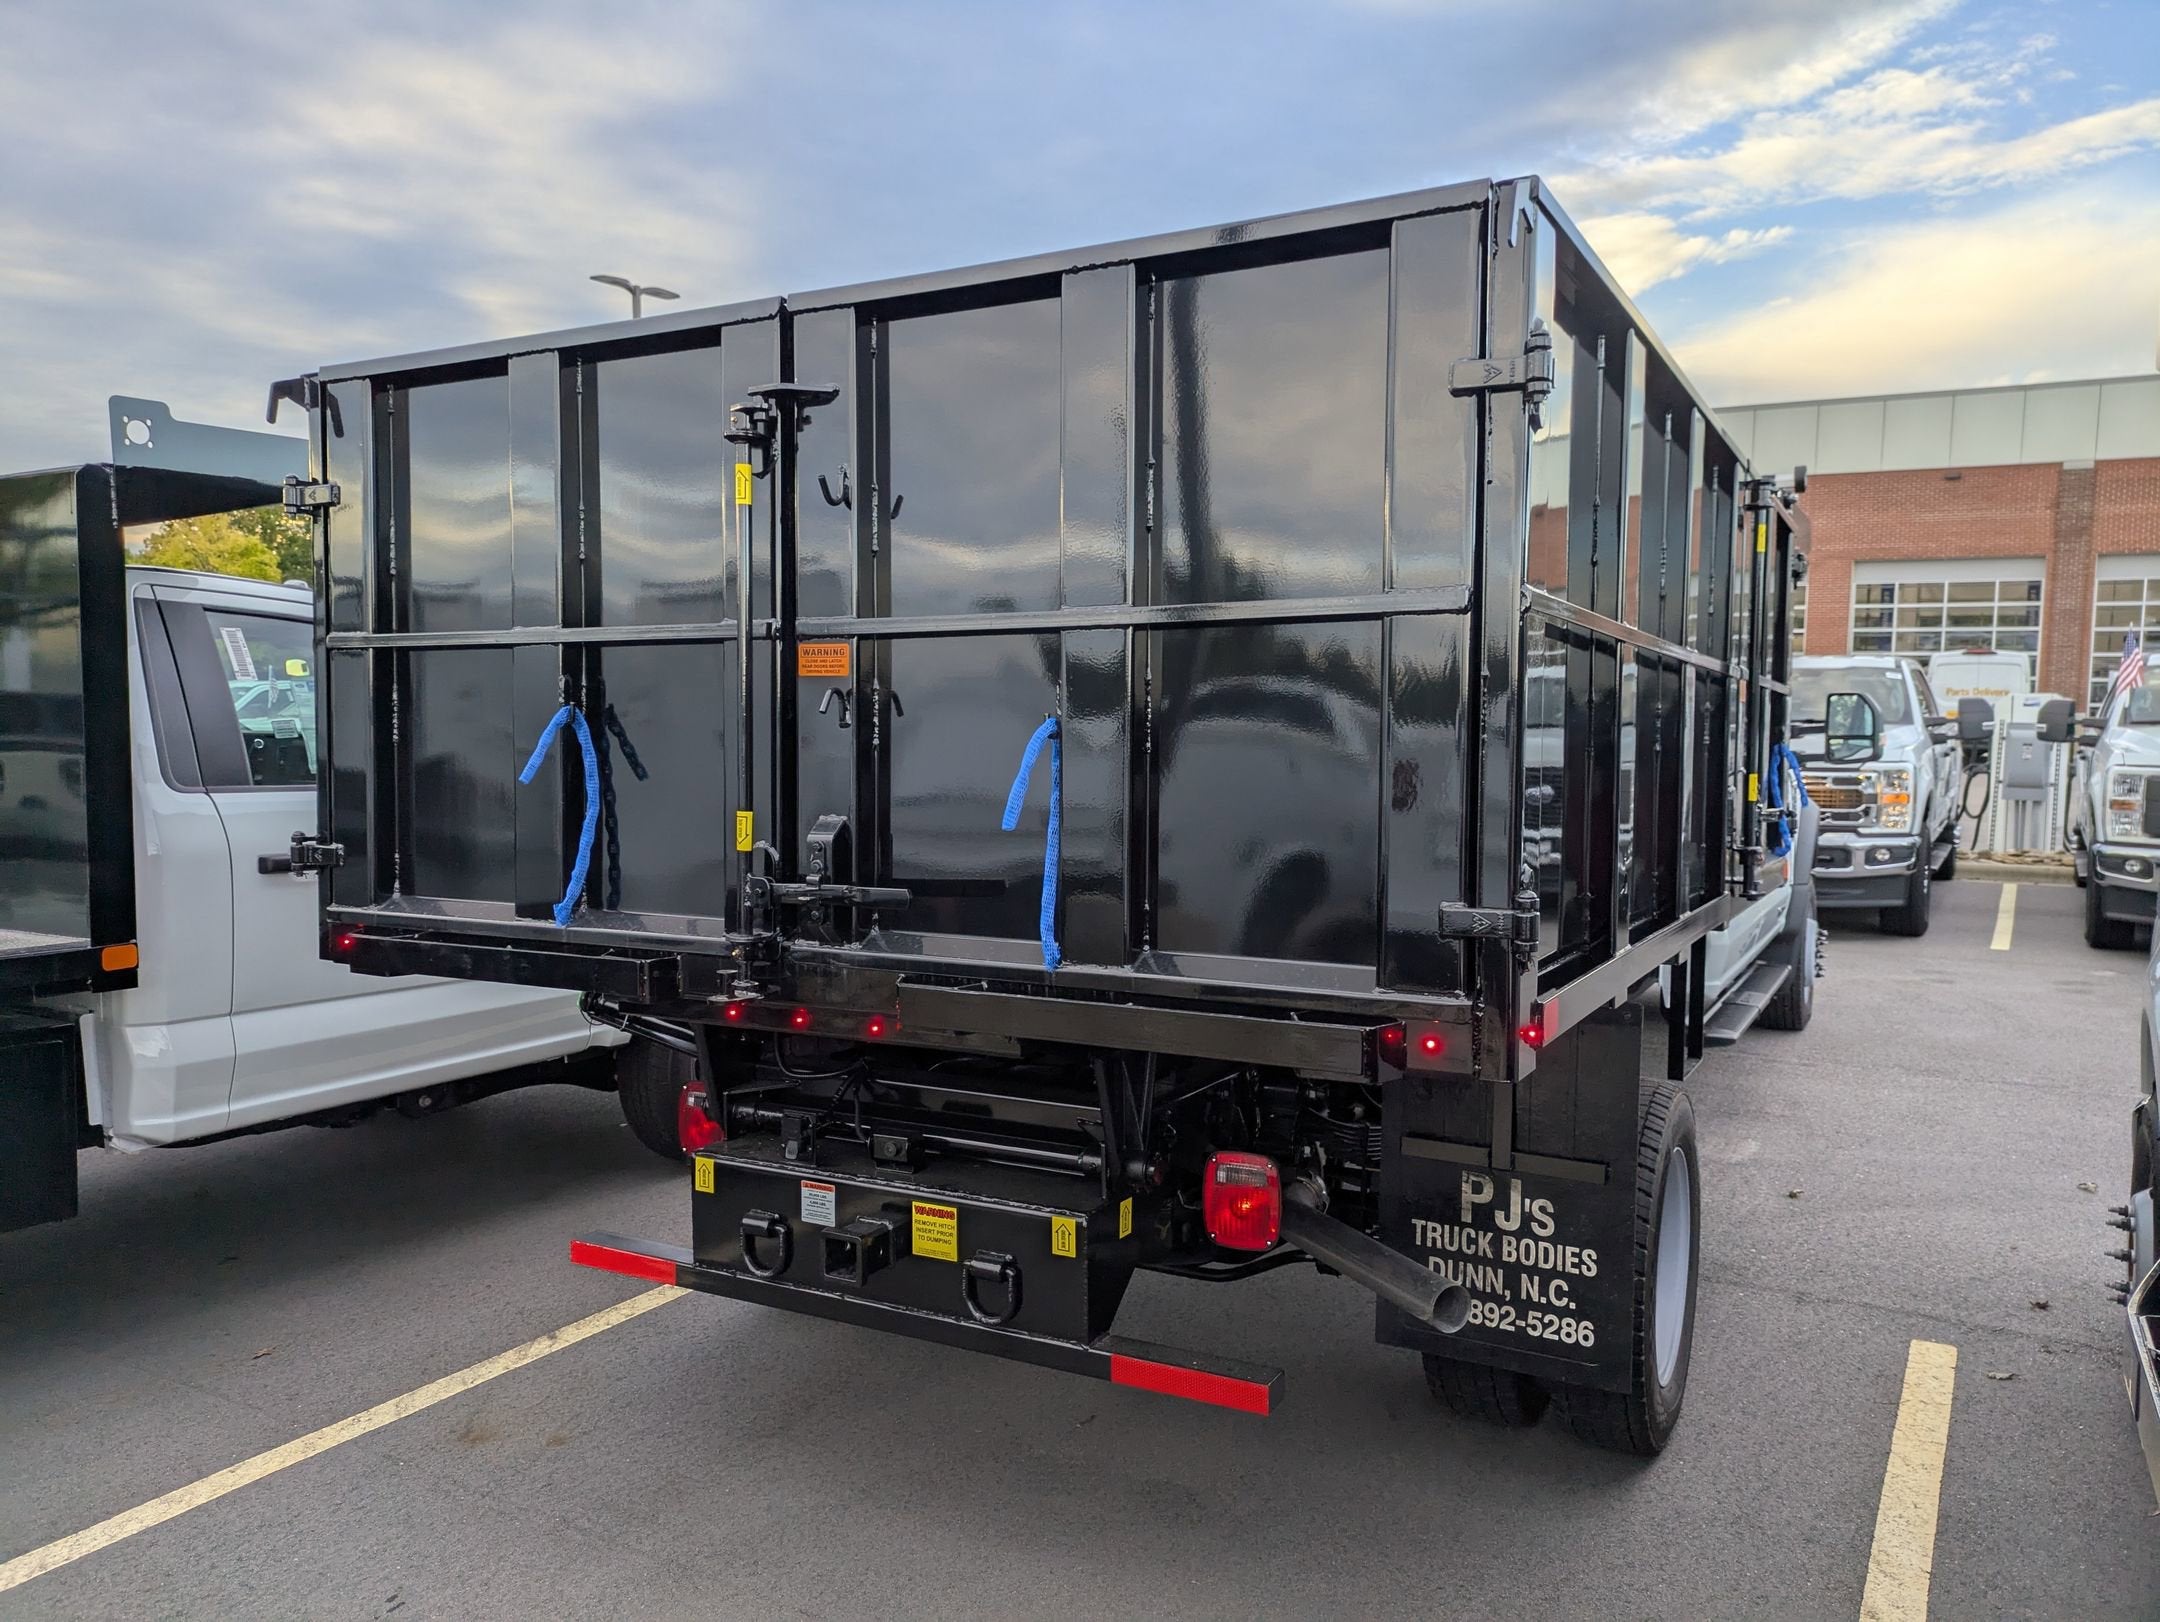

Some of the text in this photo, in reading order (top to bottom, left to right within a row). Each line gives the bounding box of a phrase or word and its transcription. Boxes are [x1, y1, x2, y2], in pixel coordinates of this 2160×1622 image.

[802, 648, 845, 656] WARNING
[1945, 687, 2010, 698] Parts Delivery
[914, 1204, 956, 1220] WARNING
[914, 1219, 938, 1228] REMOVE
[915, 1226, 954, 1238] INSERT PRIOR
[926, 1236, 952, 1246] DUMPING
[1411, 1218, 1598, 1277] TRUCK BODIES
[1520, 1273, 1577, 1310] N.C.
[1468, 1299, 1595, 1347] 892-5286
